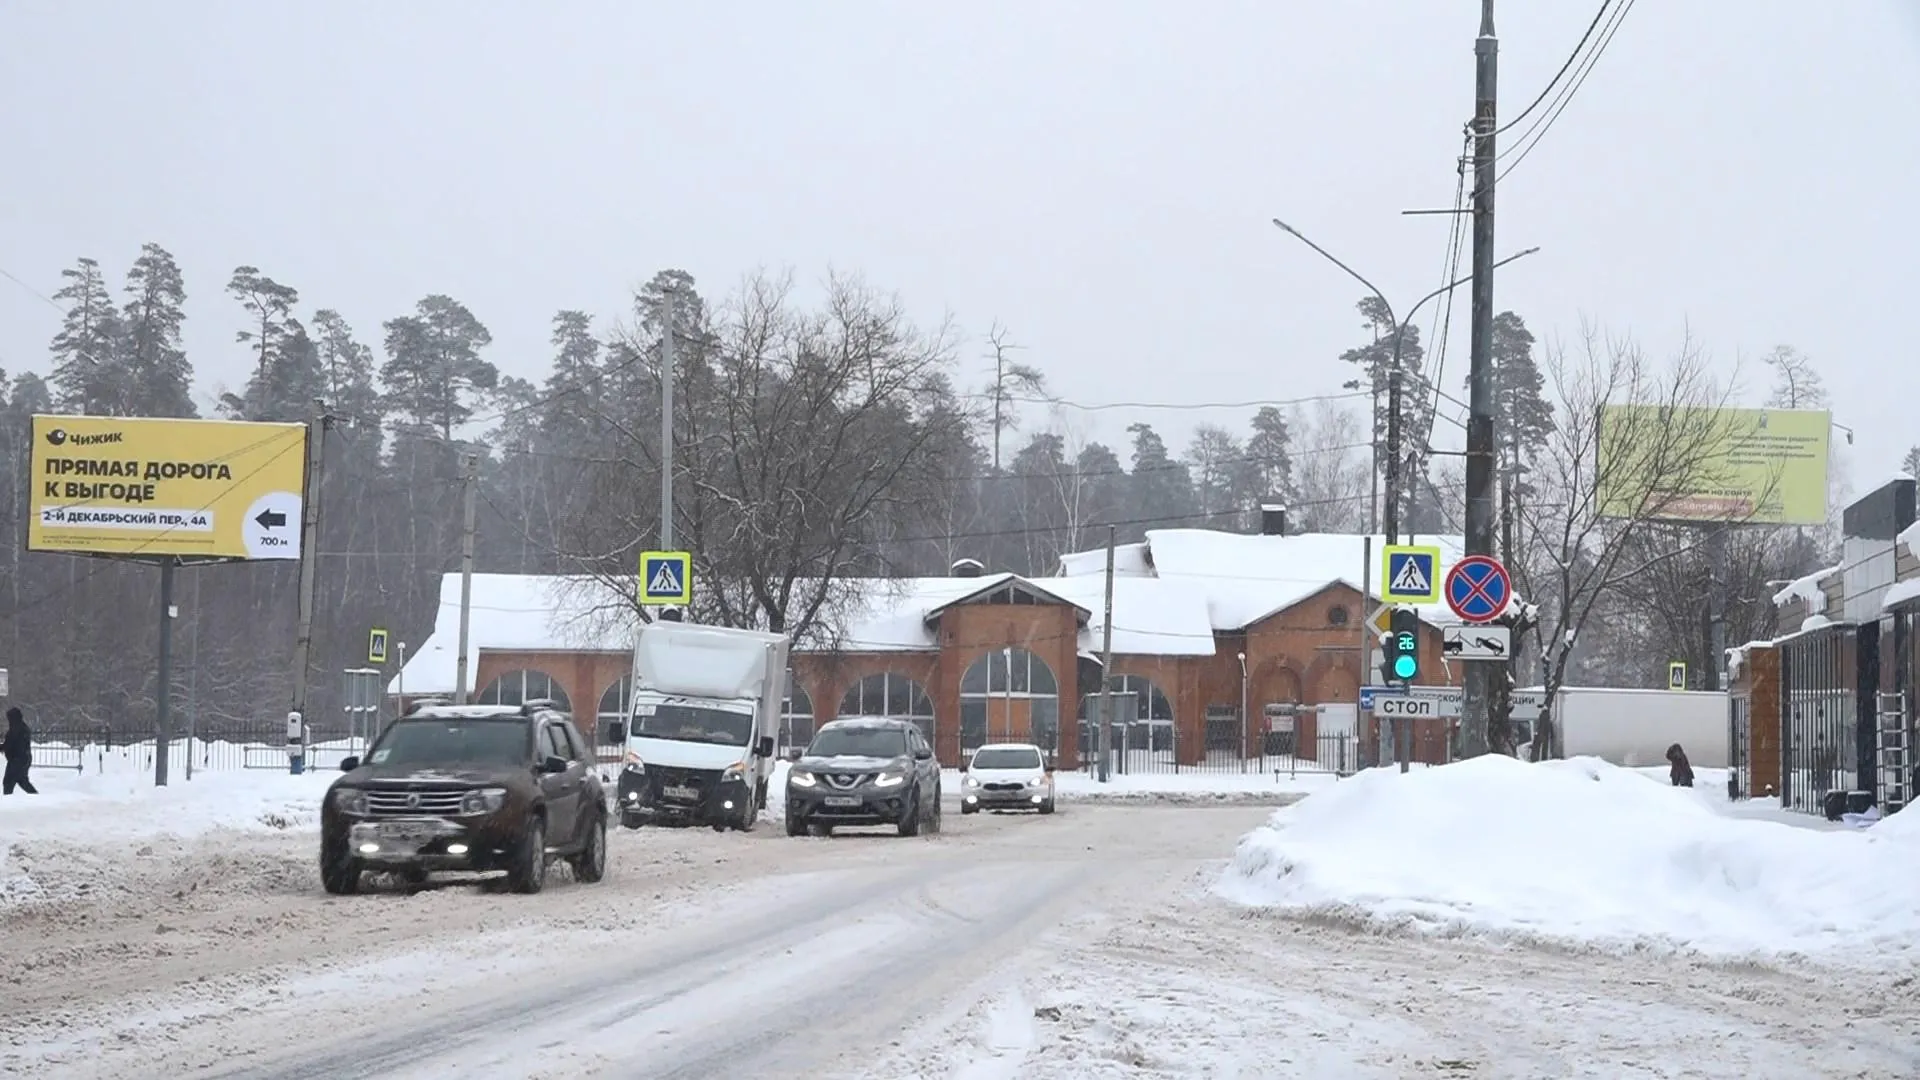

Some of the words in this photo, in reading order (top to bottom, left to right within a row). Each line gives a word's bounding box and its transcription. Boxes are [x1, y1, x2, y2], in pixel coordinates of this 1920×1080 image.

[45, 458, 138, 477] ПРЯМАЯ
[143, 462, 232, 480] ДОРОГА
[45, 481, 59, 498] К
[65, 483, 155, 503] ВЫГОДЕ
[43, 509, 65, 521] 2-Й
[67, 511, 157, 525] ДЕКАБРЬСКИЙ
[190, 516, 207, 526] 4А
[260, 536, 279, 546] 700
[1398, 637, 1414, 650] 26
[1383, 700, 1430, 714] СТОП
